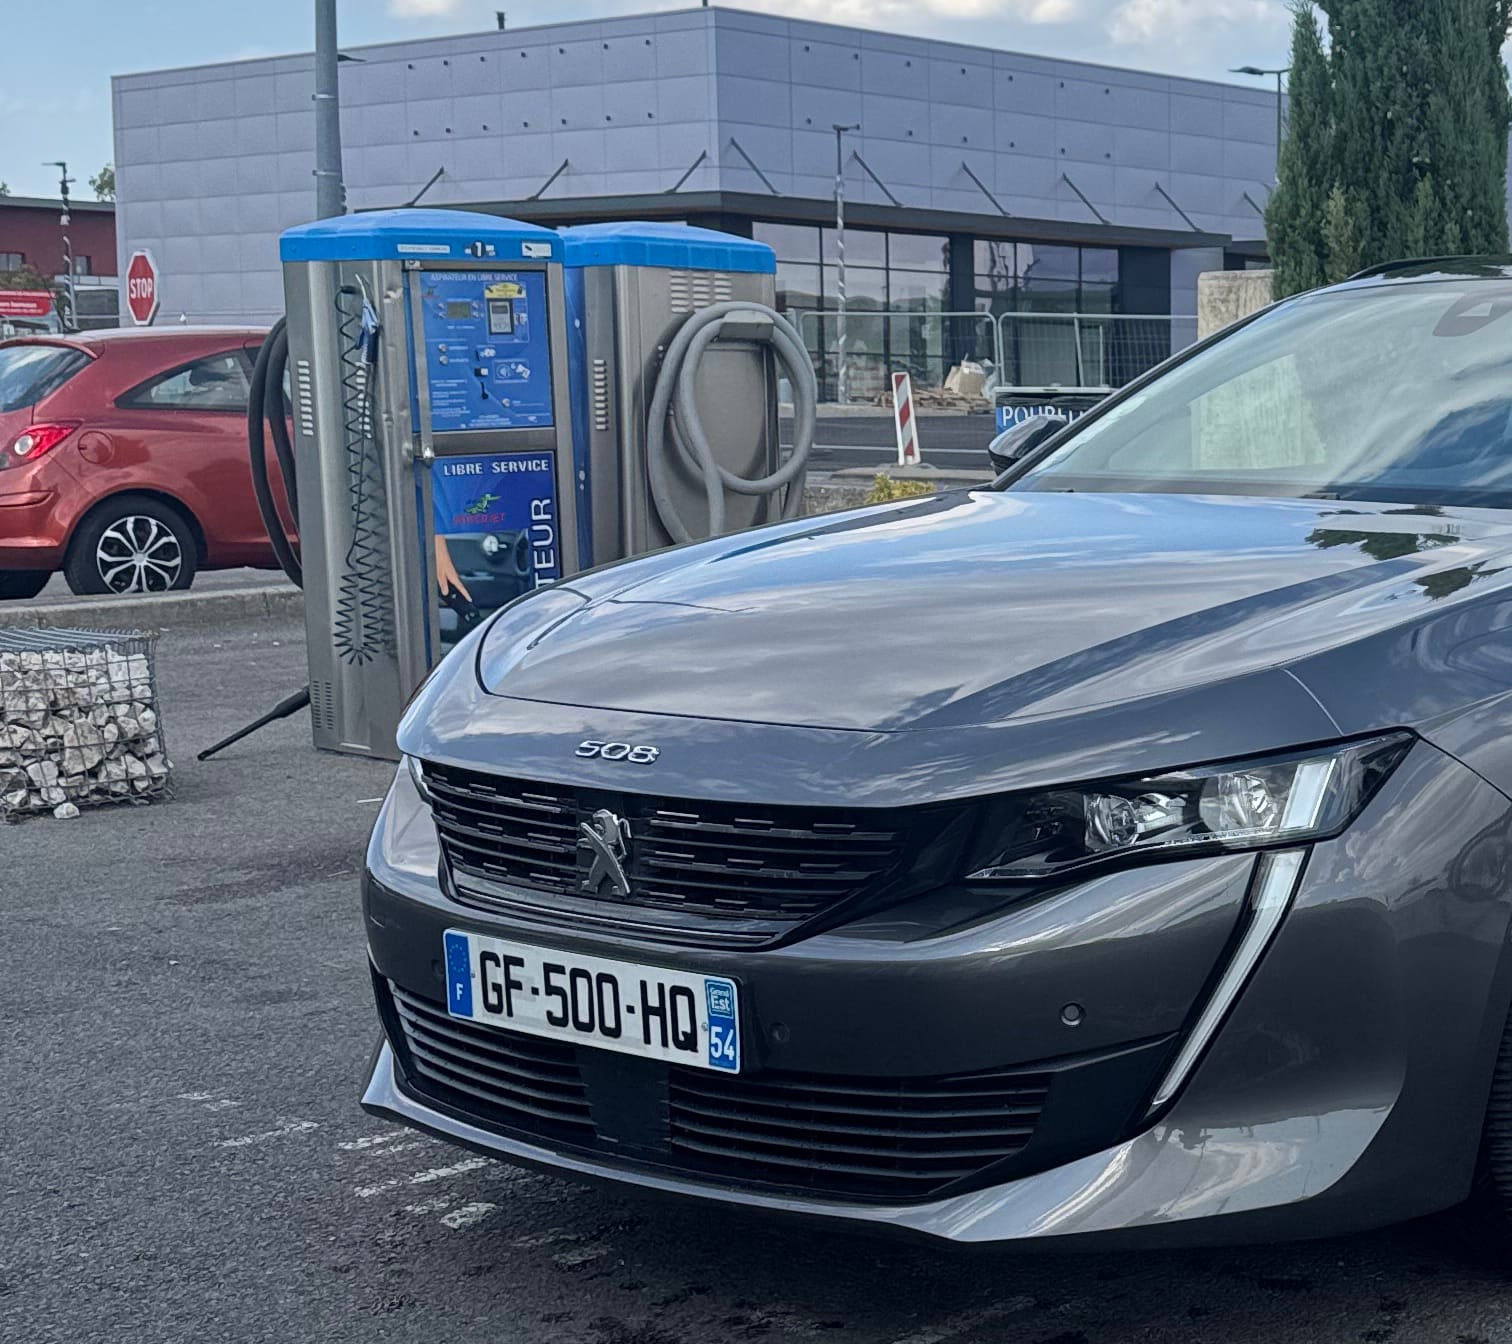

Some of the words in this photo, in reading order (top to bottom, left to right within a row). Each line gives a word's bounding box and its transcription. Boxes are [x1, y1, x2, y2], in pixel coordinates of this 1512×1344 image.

[130, 278, 152, 299] STOP
[443, 463, 484, 476] LIBRE
[491, 459, 550, 473] SERVICE
[575, 740, 660, 763] 508
[456, 983, 464, 1001] F
[479, 950, 699, 1053] GF-500-HQ
[711, 996, 731, 1011] Est
[710, 1025, 735, 1061] 54
